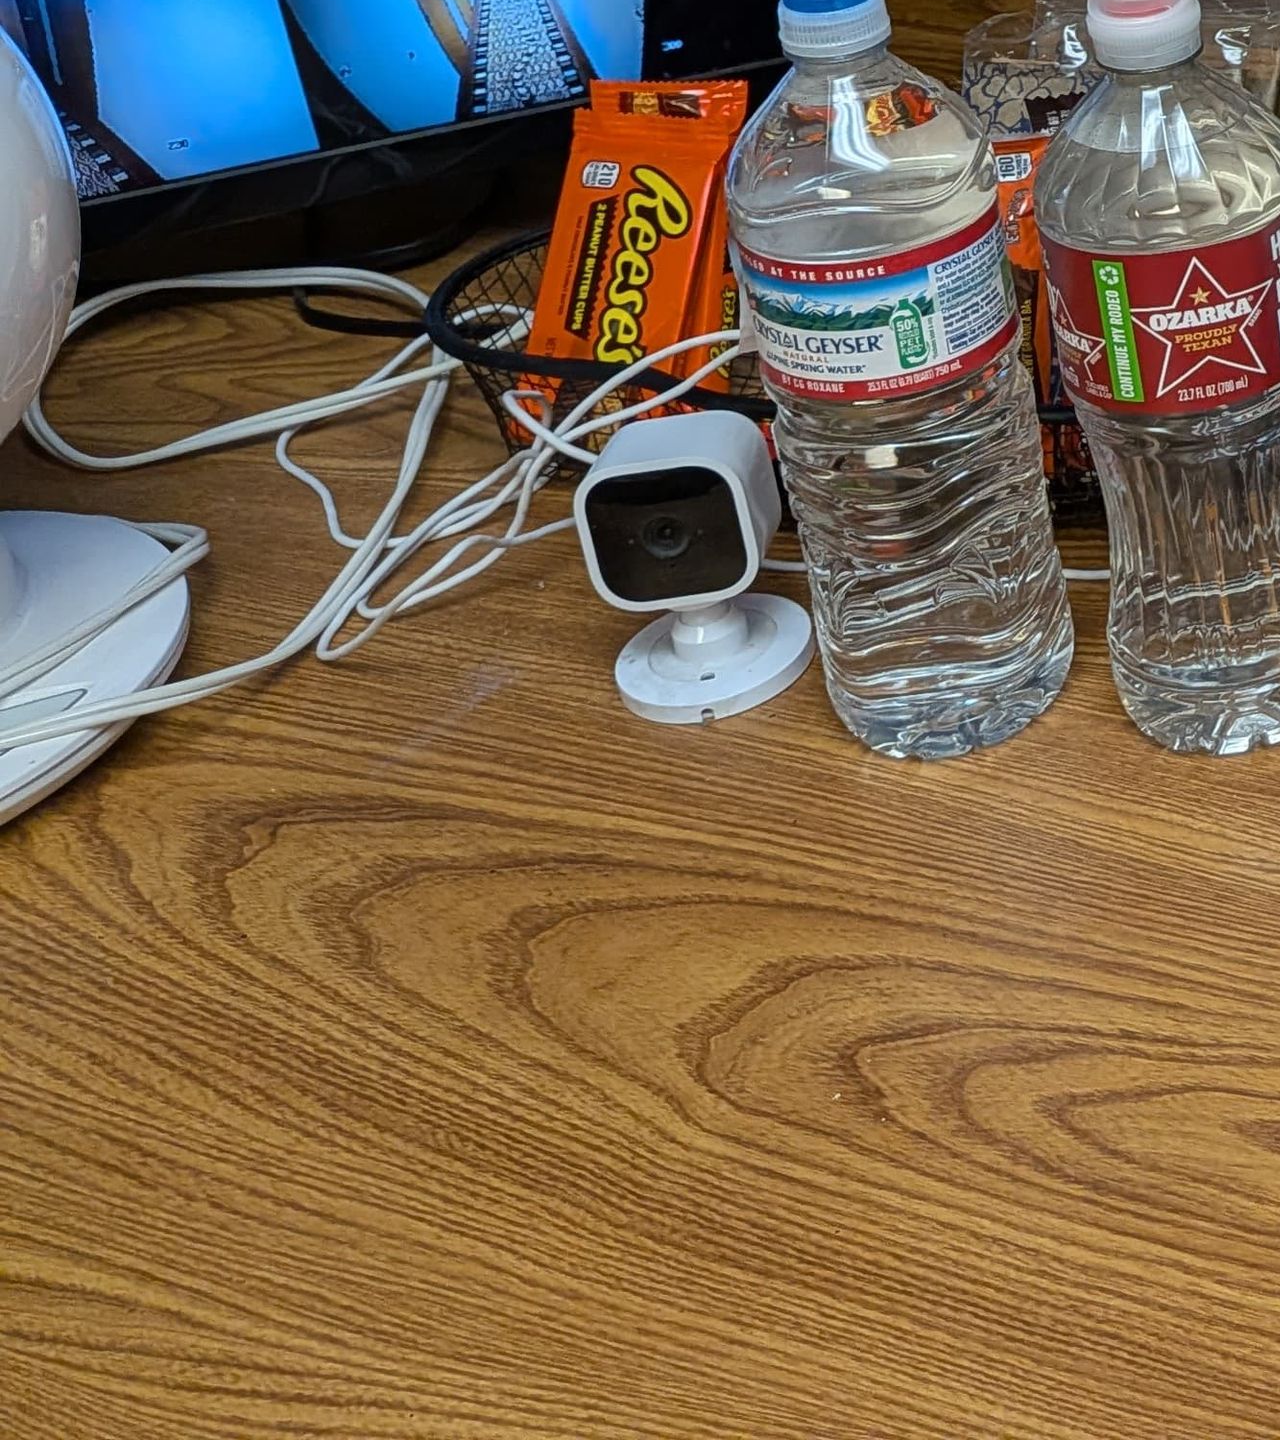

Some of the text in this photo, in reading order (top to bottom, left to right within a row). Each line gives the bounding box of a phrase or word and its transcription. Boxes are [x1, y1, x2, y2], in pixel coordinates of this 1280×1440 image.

[571, 203, 608, 331] 2 PEANUT BUTTER CUPS
[596, 166, 691, 365] Reese's
[770, 265, 887, 282] AT THE SOURCE
[1149, 297, 1252, 332] OZARKA
[753, 316, 880, 355] CRYSTAL GEYSER
[1105, 290, 1135, 398] CONTINUE MY RODEO
[1174, 323, 1239, 344] PROUDLY
[1182, 336, 1233, 353] TEXAN
[790, 359, 864, 375] SPRING WATER
